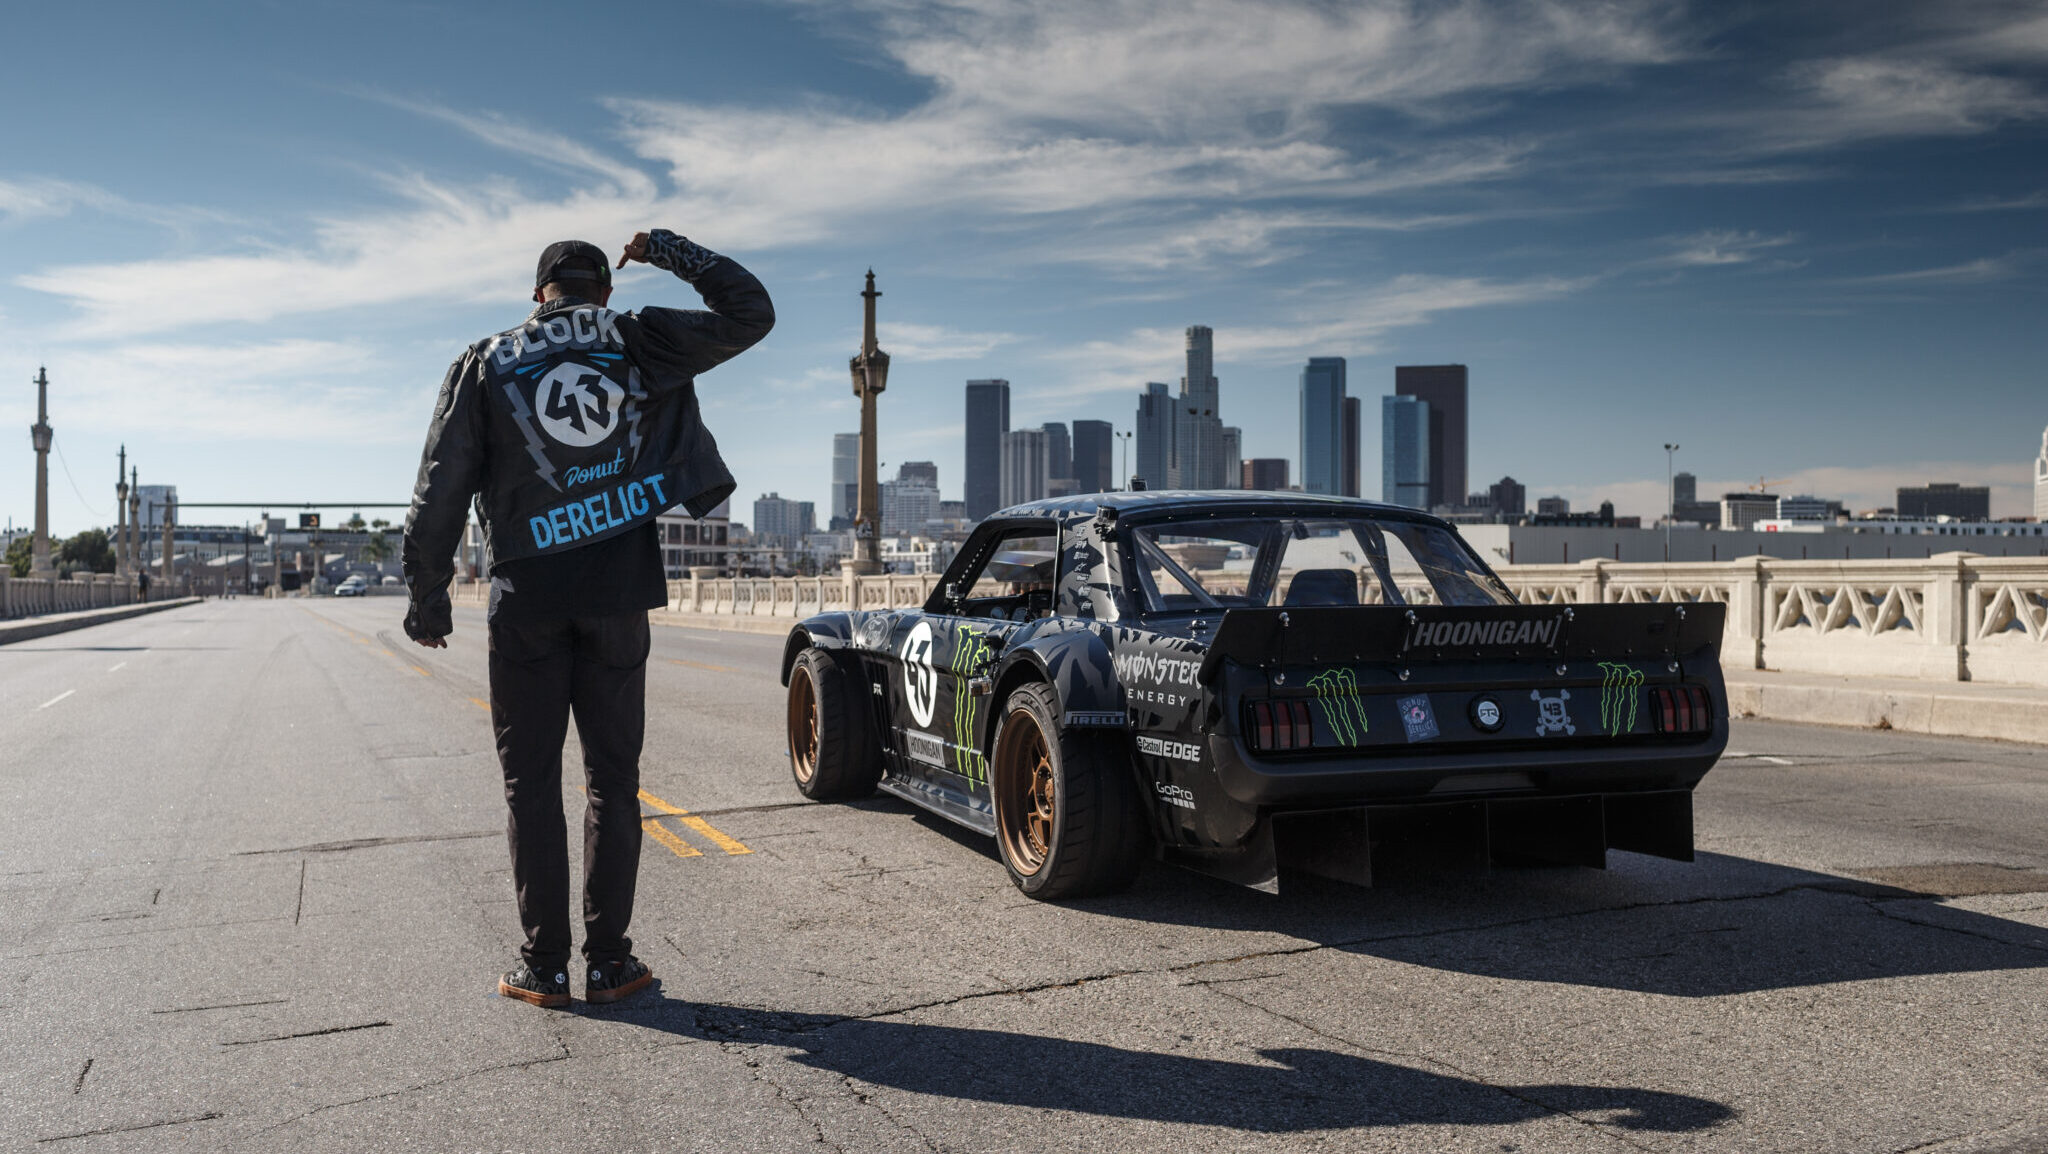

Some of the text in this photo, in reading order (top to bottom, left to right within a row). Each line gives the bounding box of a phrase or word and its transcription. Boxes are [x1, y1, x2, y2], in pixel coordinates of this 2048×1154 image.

[489, 307, 626, 370] BLOCK
[543, 372, 611, 436] 43
[563, 447, 626, 489] Donut
[528, 472, 668, 550] DERELICT
[1127, 688, 1187, 707] ENERGY
[1064, 711, 1125, 725] PIRELLI
[1543, 703, 1561, 716] 43
[1162, 740, 1201, 762] EDGE
[1155, 781, 1193, 801] GoPro
